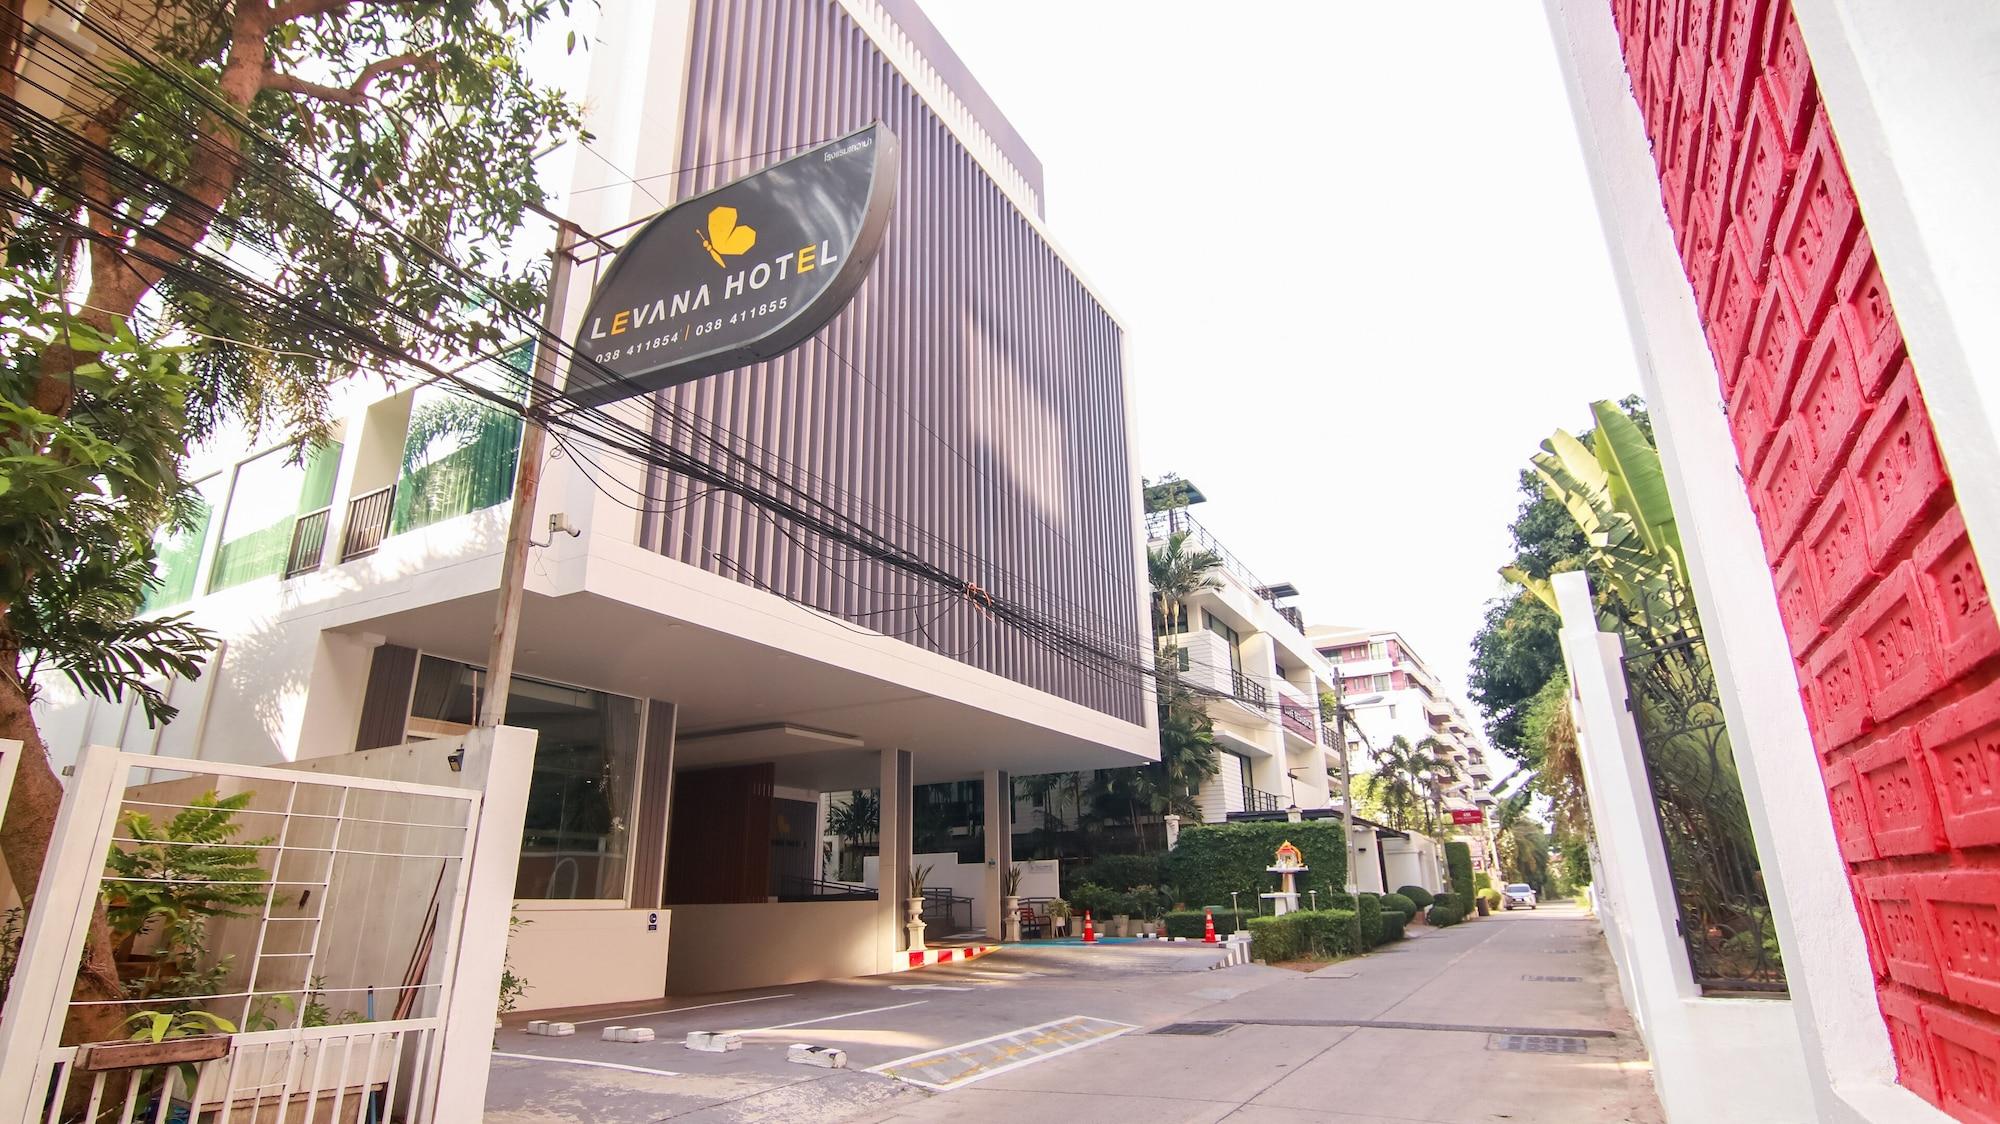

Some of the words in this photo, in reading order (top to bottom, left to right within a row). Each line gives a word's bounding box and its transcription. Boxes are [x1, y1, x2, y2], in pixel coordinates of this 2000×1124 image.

[590, 284, 710, 340] LEVANA
[724, 239, 838, 300] HOTEL
[595, 349, 621, 364] 038
[626, 331, 679, 356] 411854
[695, 318, 722, 336] 038
[729, 296, 788, 325] 411855
